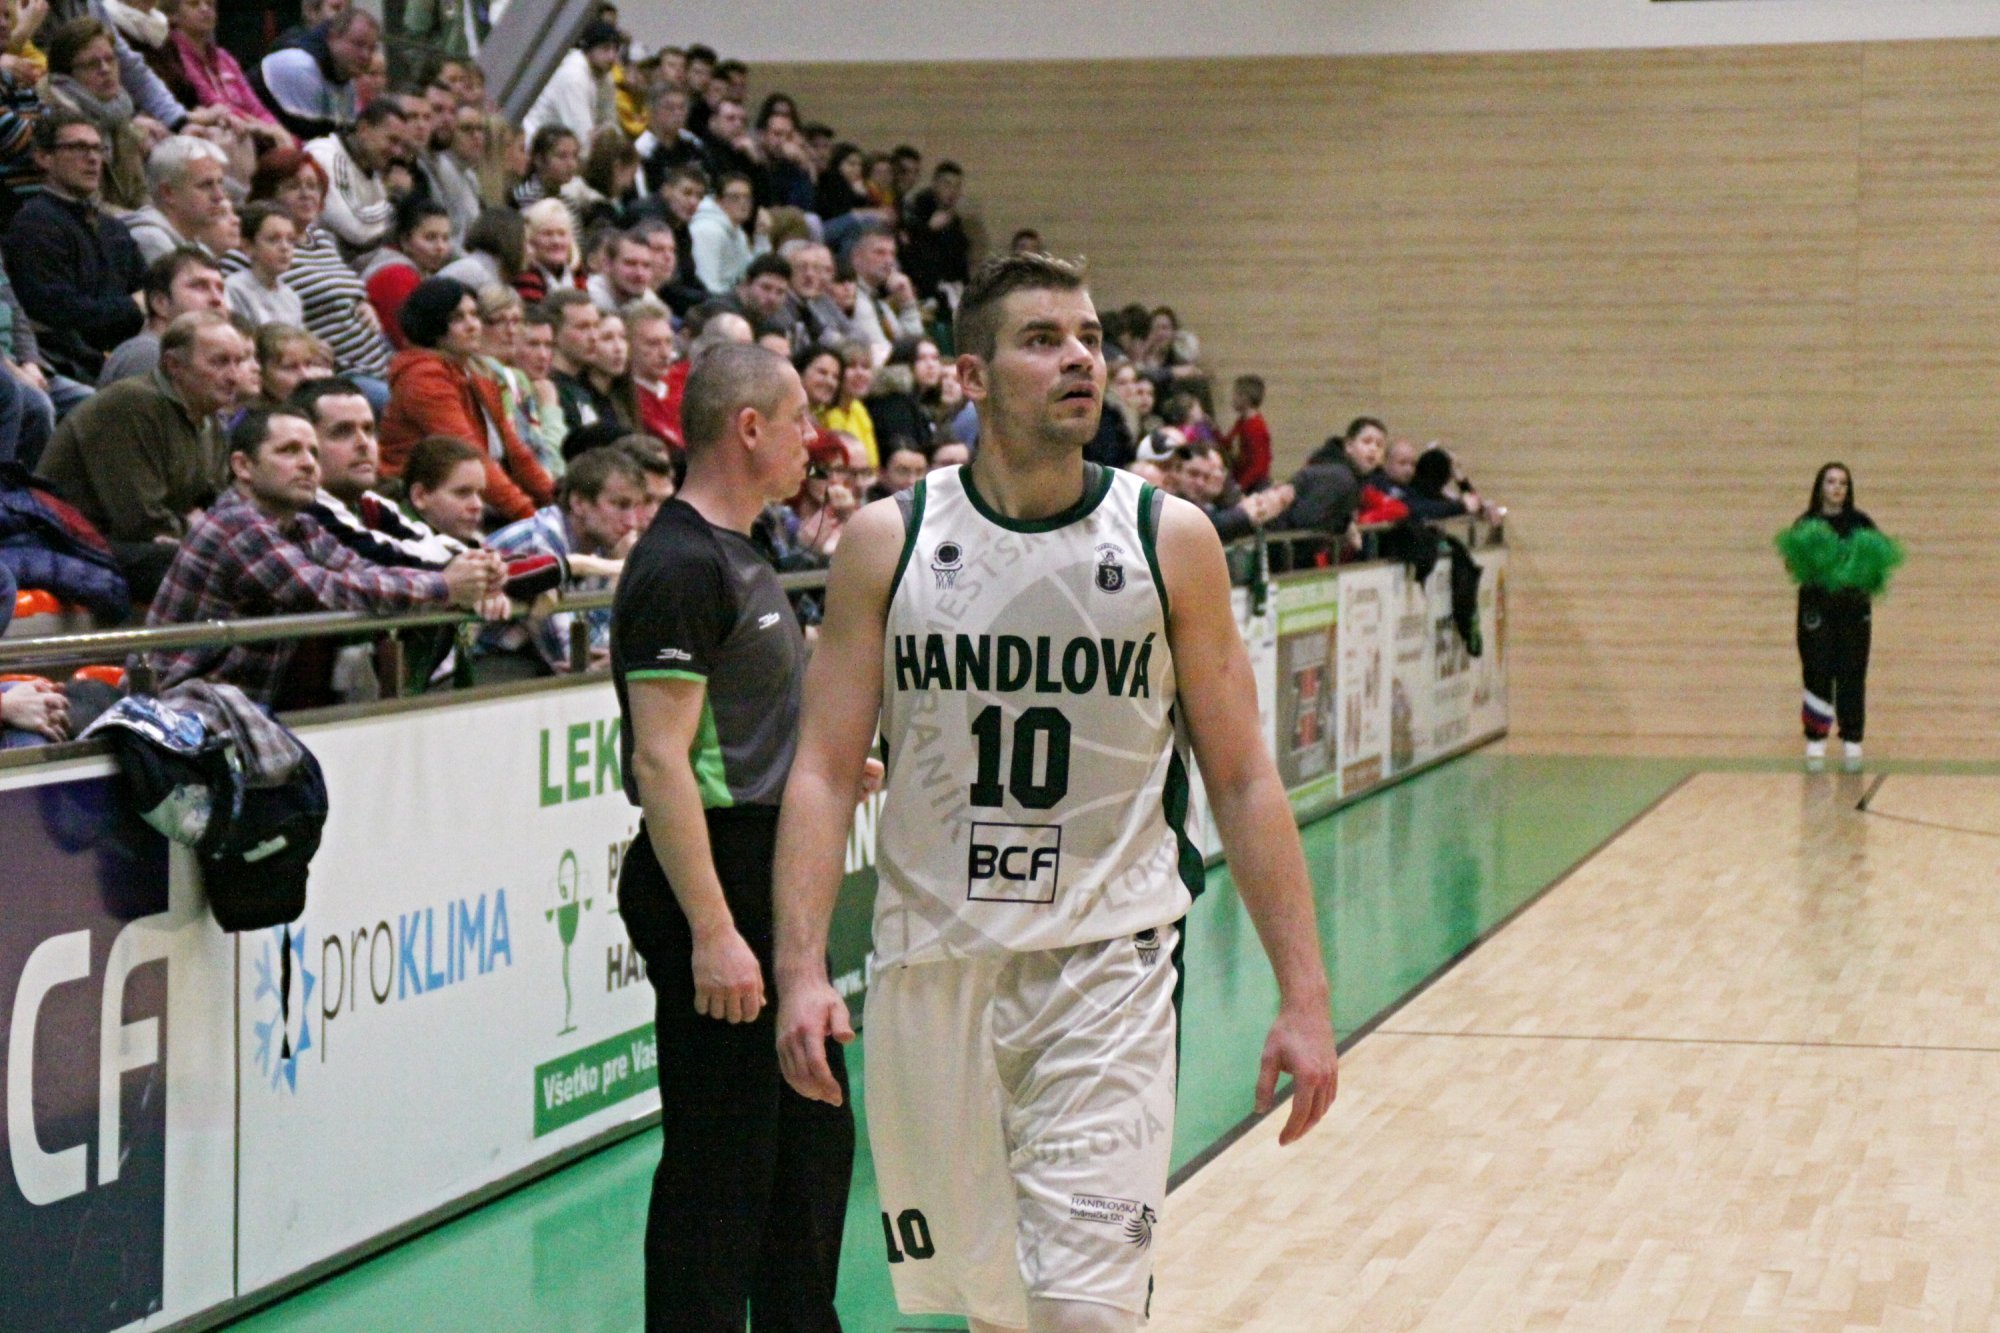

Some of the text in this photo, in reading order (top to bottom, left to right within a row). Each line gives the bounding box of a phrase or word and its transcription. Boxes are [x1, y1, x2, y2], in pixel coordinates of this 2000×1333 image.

[894, 632, 1156, 699] HANDLOVÁ
[970, 705, 1072, 810] 10
[969, 844, 1059, 881] BCF
[321, 889, 512, 1063] proKLIMA
[543, 1062, 599, 1109] Všetko
[602, 1055, 628, 1095] pre
[881, 1208, 935, 1263] 10
